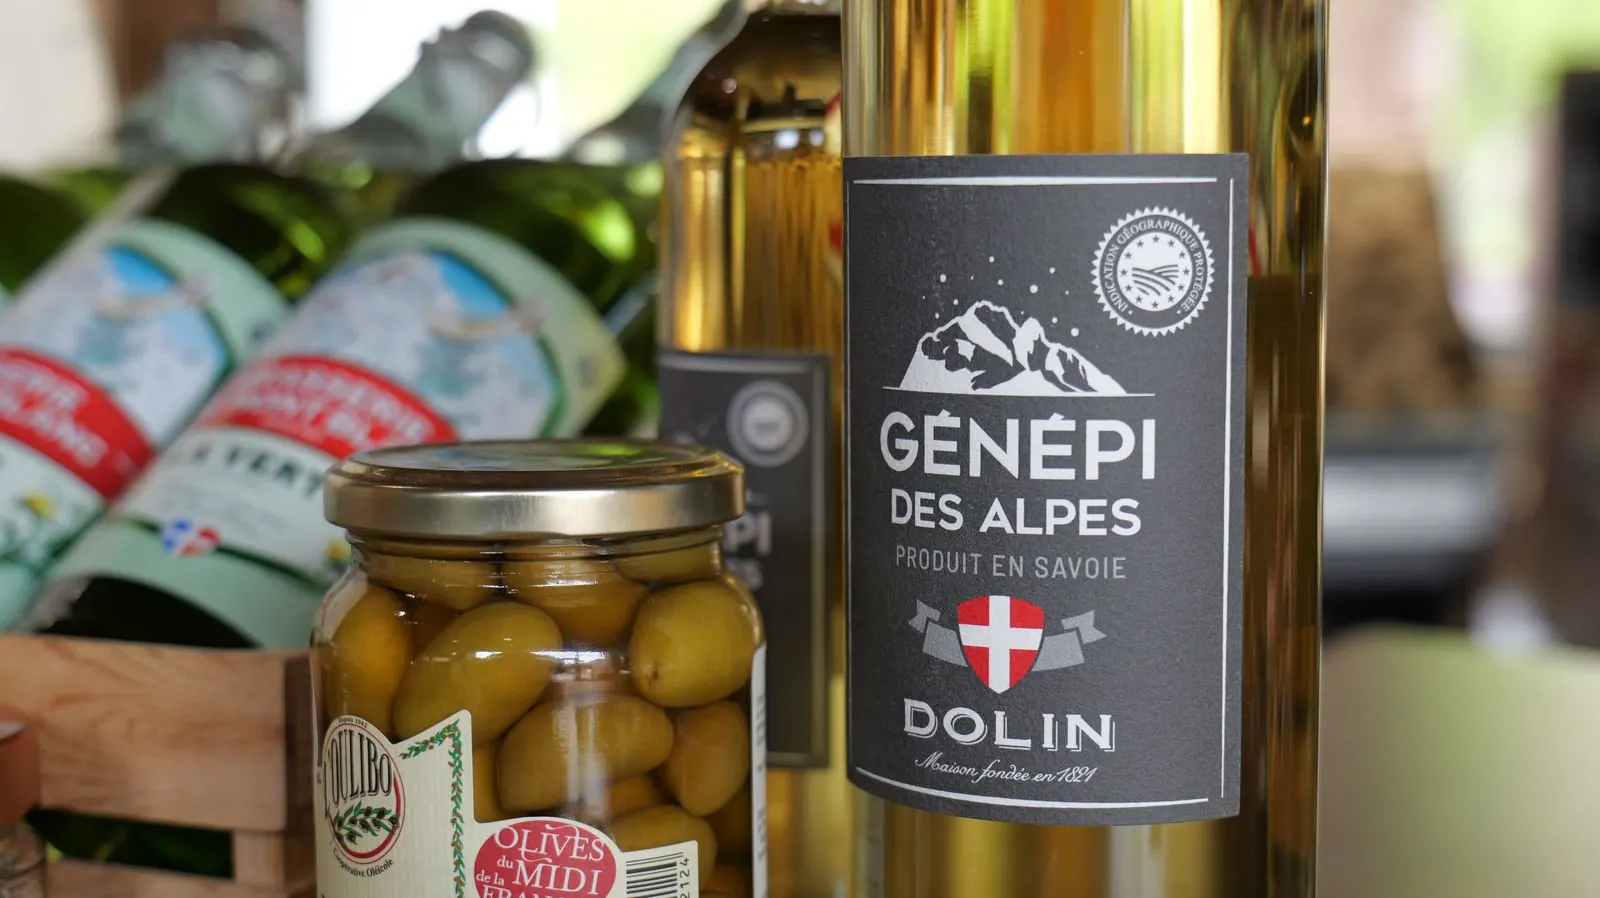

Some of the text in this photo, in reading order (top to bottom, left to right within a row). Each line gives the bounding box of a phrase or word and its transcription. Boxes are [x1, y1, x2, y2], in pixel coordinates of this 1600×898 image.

[1103, 218, 1204, 313] INDICATION GÉOGRAPHIQUE PROTÉGÉE
[880, 409, 1156, 480] GÉNÉPI
[891, 488, 1142, 536] DES ALPES
[896, 545, 1127, 579] PRODUIT EN SAVOIE
[904, 698, 1115, 752] DOLIN
[915, 752, 1098, 784] Maison fondée en 1821
[494, 823, 606, 862] OLIVES
[366, 859, 394, 877] Oléicole
[476, 870, 505, 885] de la
[497, 856, 513, 869] du
[512, 859, 602, 895] MIDI
